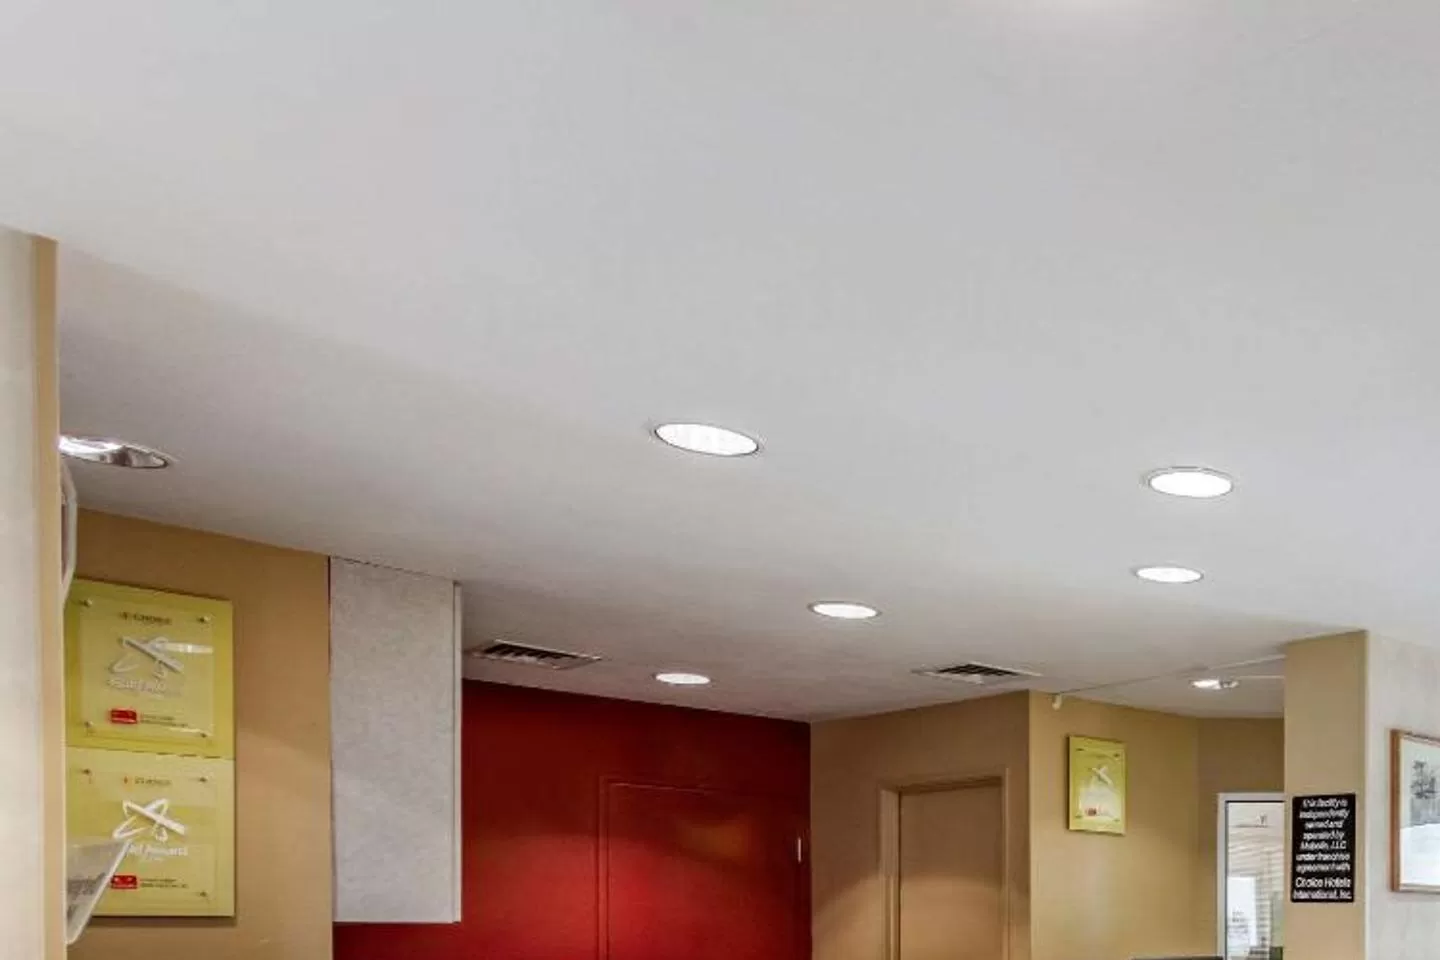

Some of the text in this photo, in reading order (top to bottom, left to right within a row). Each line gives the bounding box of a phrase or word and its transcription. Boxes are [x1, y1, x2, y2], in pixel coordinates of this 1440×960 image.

[1296, 852, 1350, 861] under franchise
[1296, 863, 1334, 874] agreement
[1295, 877, 1351, 888] Choice Hotels
